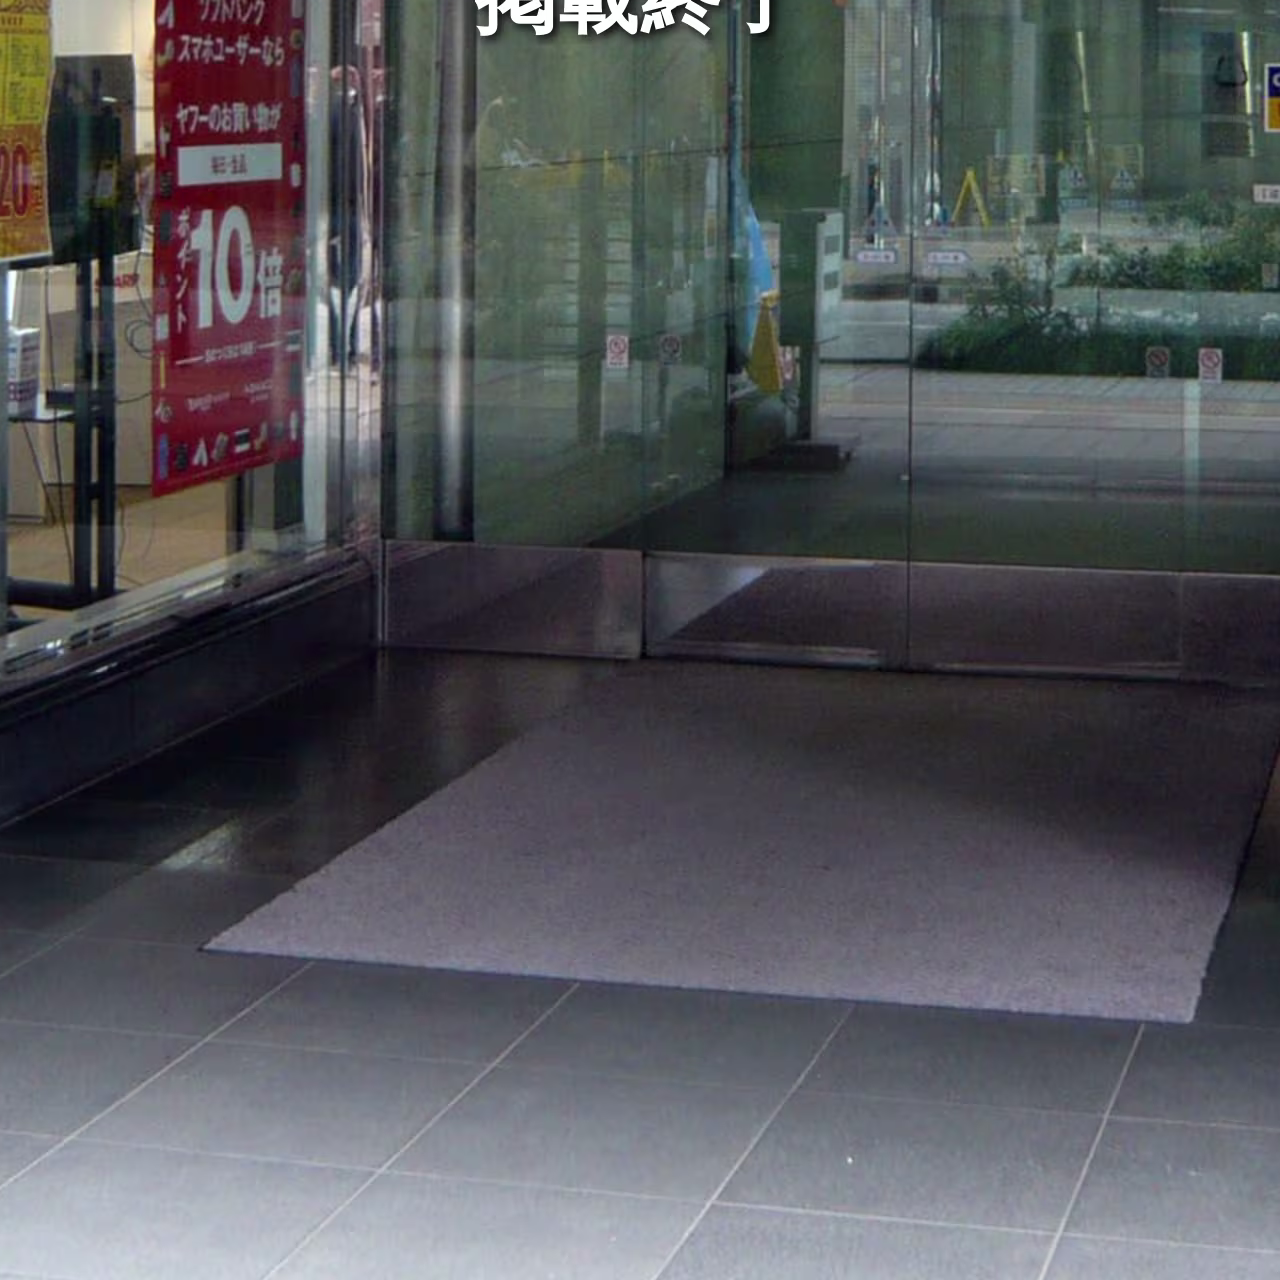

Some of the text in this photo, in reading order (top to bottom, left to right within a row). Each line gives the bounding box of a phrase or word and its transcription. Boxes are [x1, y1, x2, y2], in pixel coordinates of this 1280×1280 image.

[177, 33, 286, 67] スマホユーザーなら
[176, 205, 192, 334] ポイント
